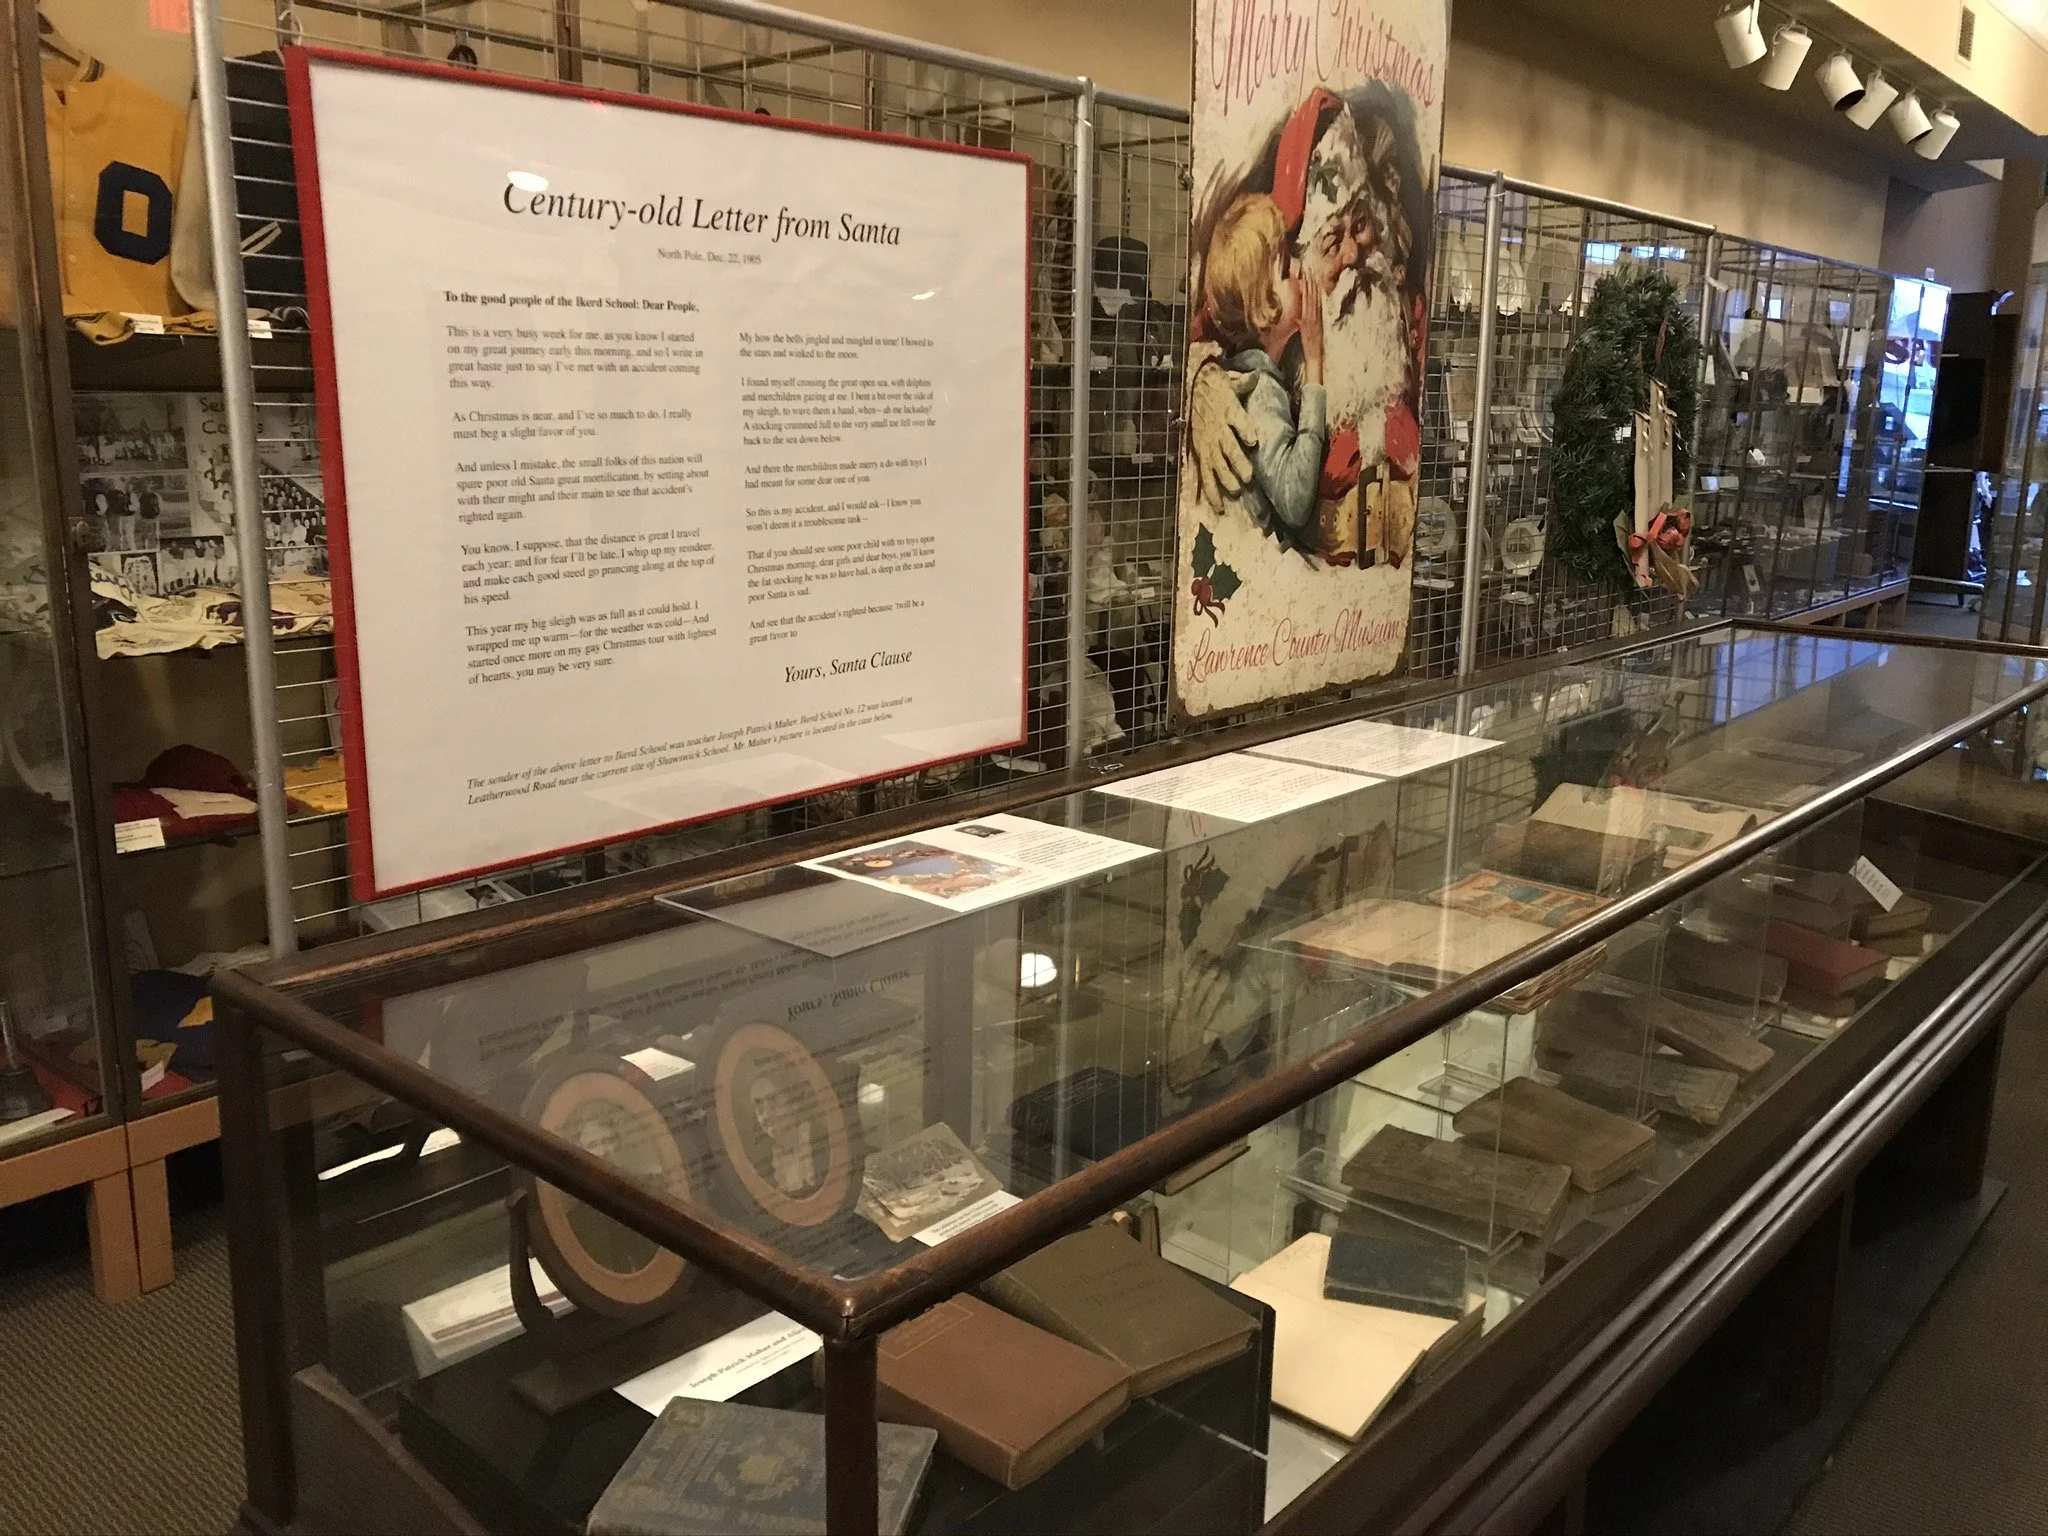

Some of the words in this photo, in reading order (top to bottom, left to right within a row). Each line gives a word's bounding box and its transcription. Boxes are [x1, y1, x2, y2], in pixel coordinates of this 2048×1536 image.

[1211, 0, 1310, 117] Merry
[1315, 0, 1436, 108] Christmas
[504, 179, 683, 230] Century-old
[691, 198, 768, 232] Letter
[771, 206, 829, 243] from
[838, 213, 899, 245] Santa
[443, 290, 458, 301] To
[460, 291, 477, 303] the
[480, 293, 506, 305] good
[509, 294, 542, 307] people
[544, 295, 555, 305] of
[557, 295, 572, 306] the
[575, 296, 602, 307] Ikerd
[642, 298, 664, 310] Dear
[455, 461, 477, 472] And
[479, 460, 511, 471] unless
[561, 457, 575, 468] the
[578, 456, 602, 467] small
[604, 456, 627, 466] folks
[628, 455, 638, 465] of
[640, 455, 656, 465] this
[658, 456, 684, 464] nation
[686, 453, 702, 463] will
[456, 480, 482, 491] spare
[485, 479, 508, 490] poor
[510, 476, 526, 486] old
[528, 475, 554, 485] Santa
[557, 475, 580, 487] great
[643, 470, 653, 482] by
[656, 471, 684, 481] setting
[686, 468, 708, 478] about
[457, 494, 479, 505] with
[482, 494, 505, 504] their
[507, 491, 535, 505] might
[538, 490, 555, 501] and
[557, 490, 578, 500] their
[580, 490, 603, 499] main
[605, 489, 614, 497] to
[616, 488, 630, 497] see
[632, 486, 649, 496] that
[458, 510, 493, 524] righted
[464, 625, 488, 636] This
[490, 624, 511, 636] year
[513, 622, 528, 632] my
[530, 618, 546, 630] big
[548, 614, 576, 627] sleigh
[578, 614, 596, 622] was
[609, 608, 624, 619] full
[626, 609, 636, 617] as
[638, 608, 644, 616] it
[646, 603, 670, 615] could
[466, 638, 508, 652] wrapped
[511, 638, 525, 646] me
[528, 636, 540, 646] up
[594, 626, 608, 636] the
[610, 622, 644, 633] weather
[467, 654, 500, 668] started
[502, 654, 525, 663] once
[528, 650, 551, 660] more
[553, 648, 565, 656] on
[567, 647, 581, 656] my
[584, 644, 599, 655] gay
[602, 638, 646, 650] Christmas
[647, 635, 664, 644] tour
[667, 631, 685, 640] with
[687, 627, 716, 640] lightest
[1187, 628, 1269, 683] Lawrence
[1272, 617, 1331, 667] County
[1334, 608, 1400, 653] Museum
[468, 673, 479, 684] of
[516, 668, 534, 680] you
[536, 665, 555, 675] may
[558, 662, 569, 671] be
[572, 660, 590, 670] very
[785, 665, 825, 682] Yours,
[829, 658, 866, 675] Santa
[870, 650, 912, 668] Clause
